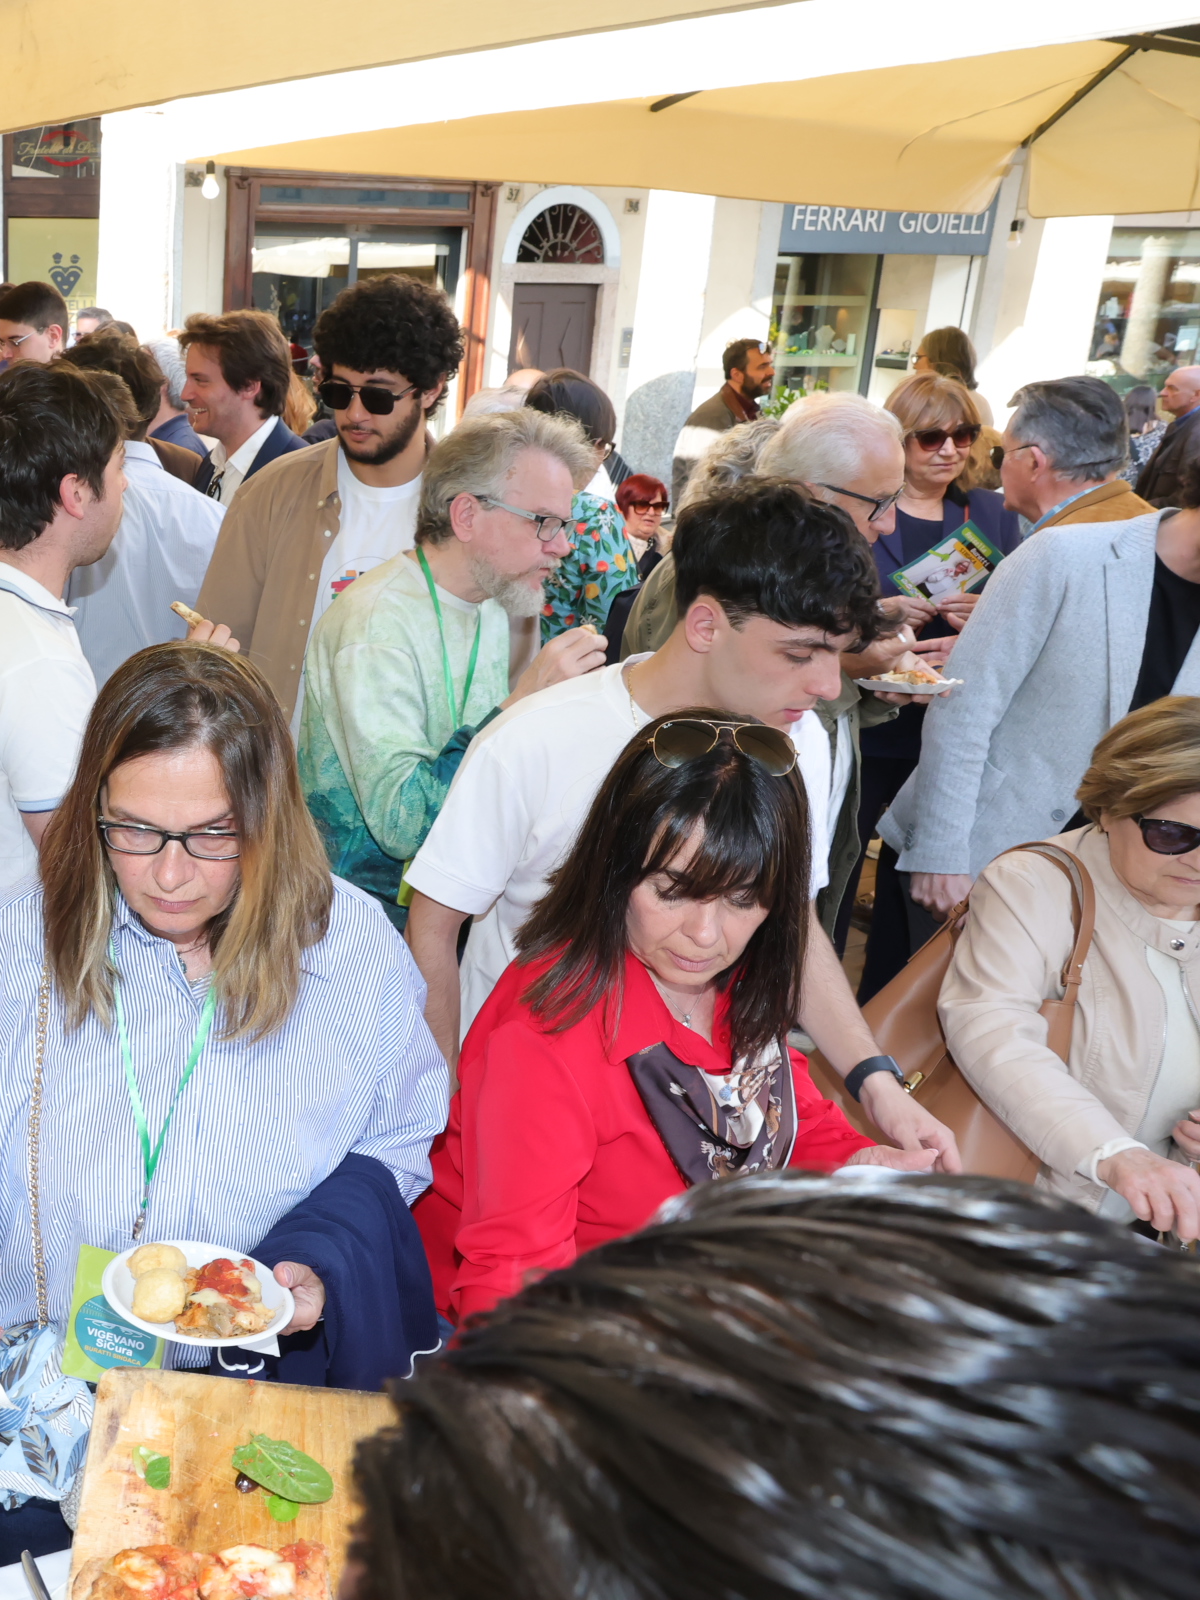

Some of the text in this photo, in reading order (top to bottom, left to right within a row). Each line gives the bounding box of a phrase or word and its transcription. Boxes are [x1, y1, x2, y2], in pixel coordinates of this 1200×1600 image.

[791, 205, 990, 234] FERRARI GIOIELLI
[87, 1326, 145, 1350] VIGEVANO
[96, 1338, 133, 1357] SiCura
[84, 1345, 142, 1366] BURATTI SINDACA
